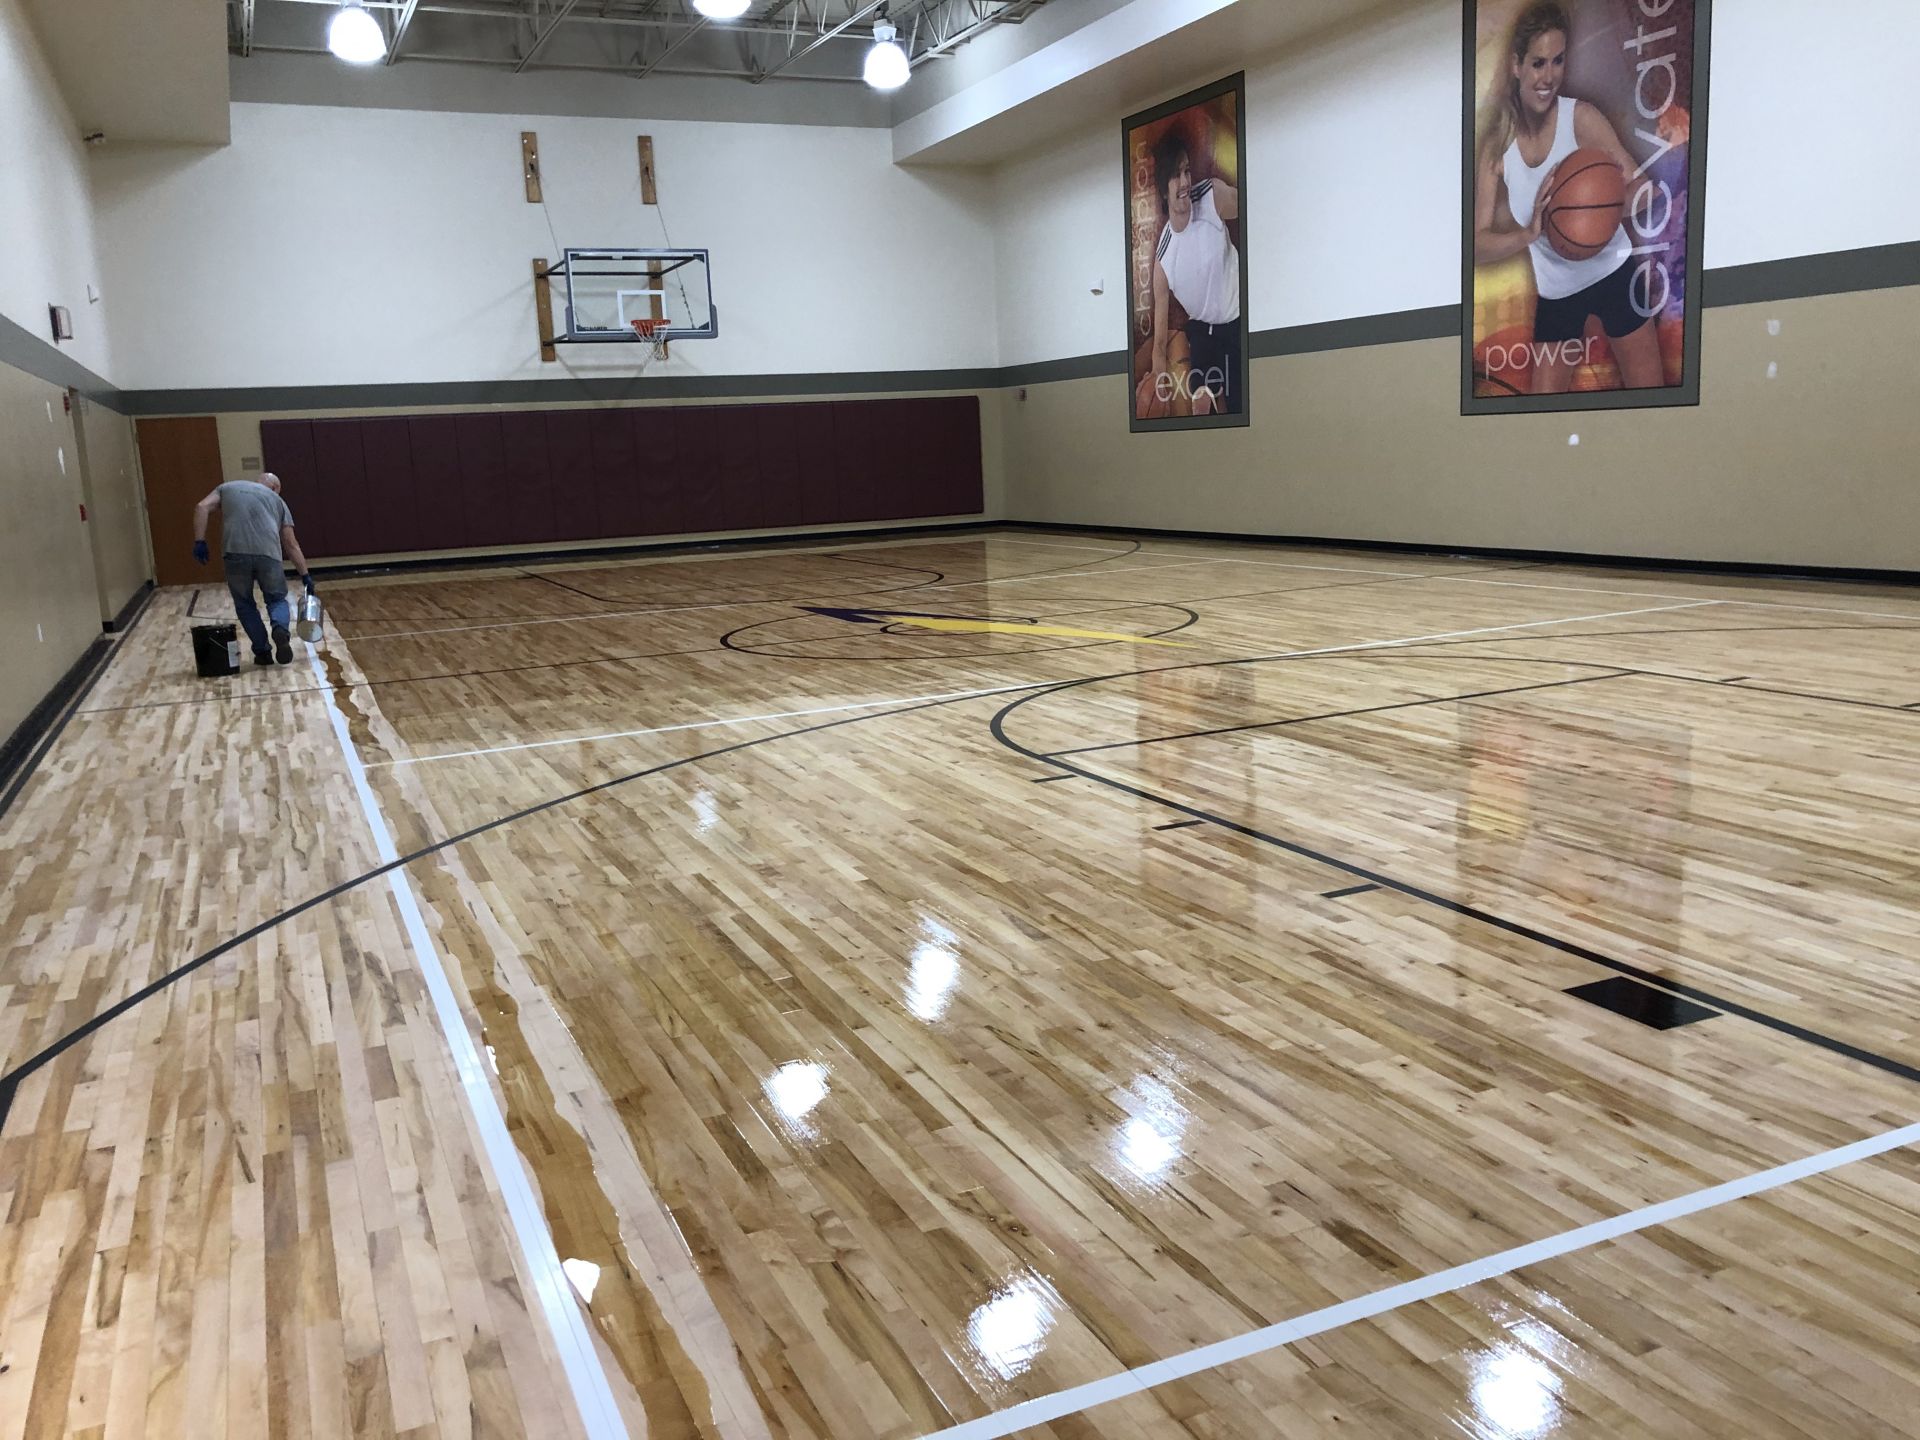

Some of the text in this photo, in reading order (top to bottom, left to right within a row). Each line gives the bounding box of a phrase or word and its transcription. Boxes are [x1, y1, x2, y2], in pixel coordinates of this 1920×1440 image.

[1133, 141, 1155, 337] champion
[1155, 354, 1230, 402] excel
[1485, 335, 1598, 380] power
